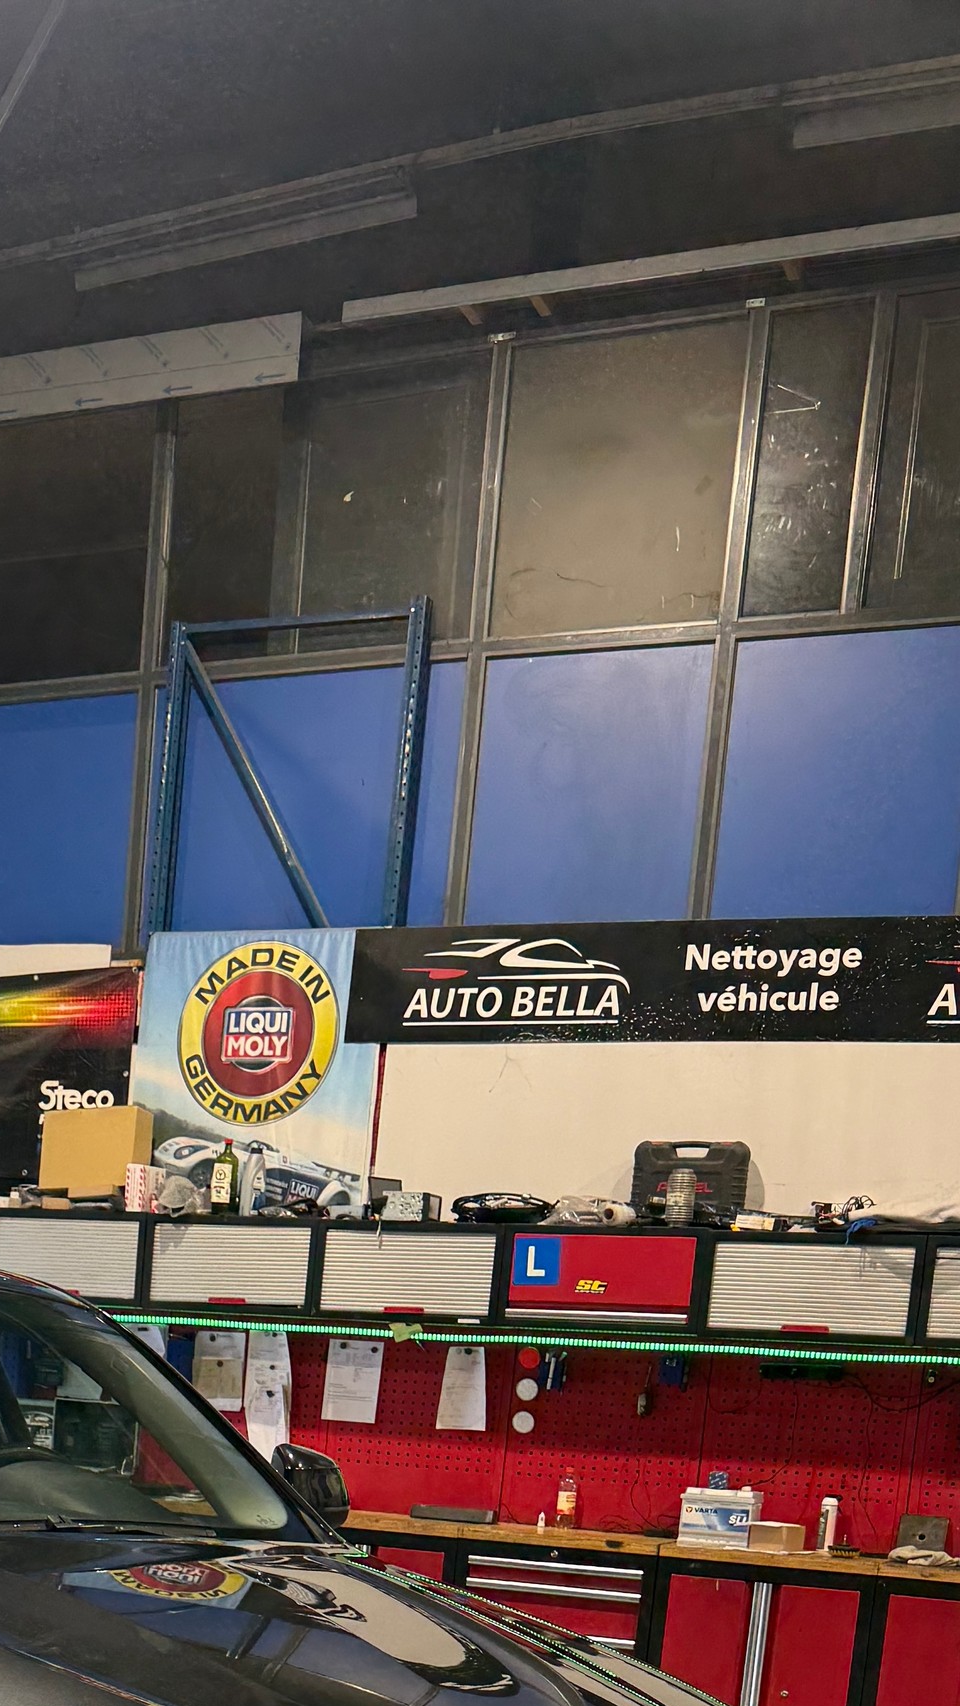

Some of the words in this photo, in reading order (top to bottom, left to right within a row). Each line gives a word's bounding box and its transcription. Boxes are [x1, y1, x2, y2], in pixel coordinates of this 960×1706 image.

[684, 943, 863, 978] Nettoyage
[194, 948, 301, 1006] MADE
[299, 966, 331, 1005] IN
[403, 986, 503, 1019] AUTO
[511, 985, 620, 1017] BELLA
[697, 982, 841, 1012] véhicule
[228, 1012, 289, 1034] LIQUI
[227, 1035, 289, 1057] MOLY
[38, 1080, 115, 1111] Steco
[185, 1053, 322, 1122] GERMANY
[291, 1180, 318, 1199] LIQUI
[527, 1245, 546, 1277] L
[694, 1507, 718, 1515] VARTA
